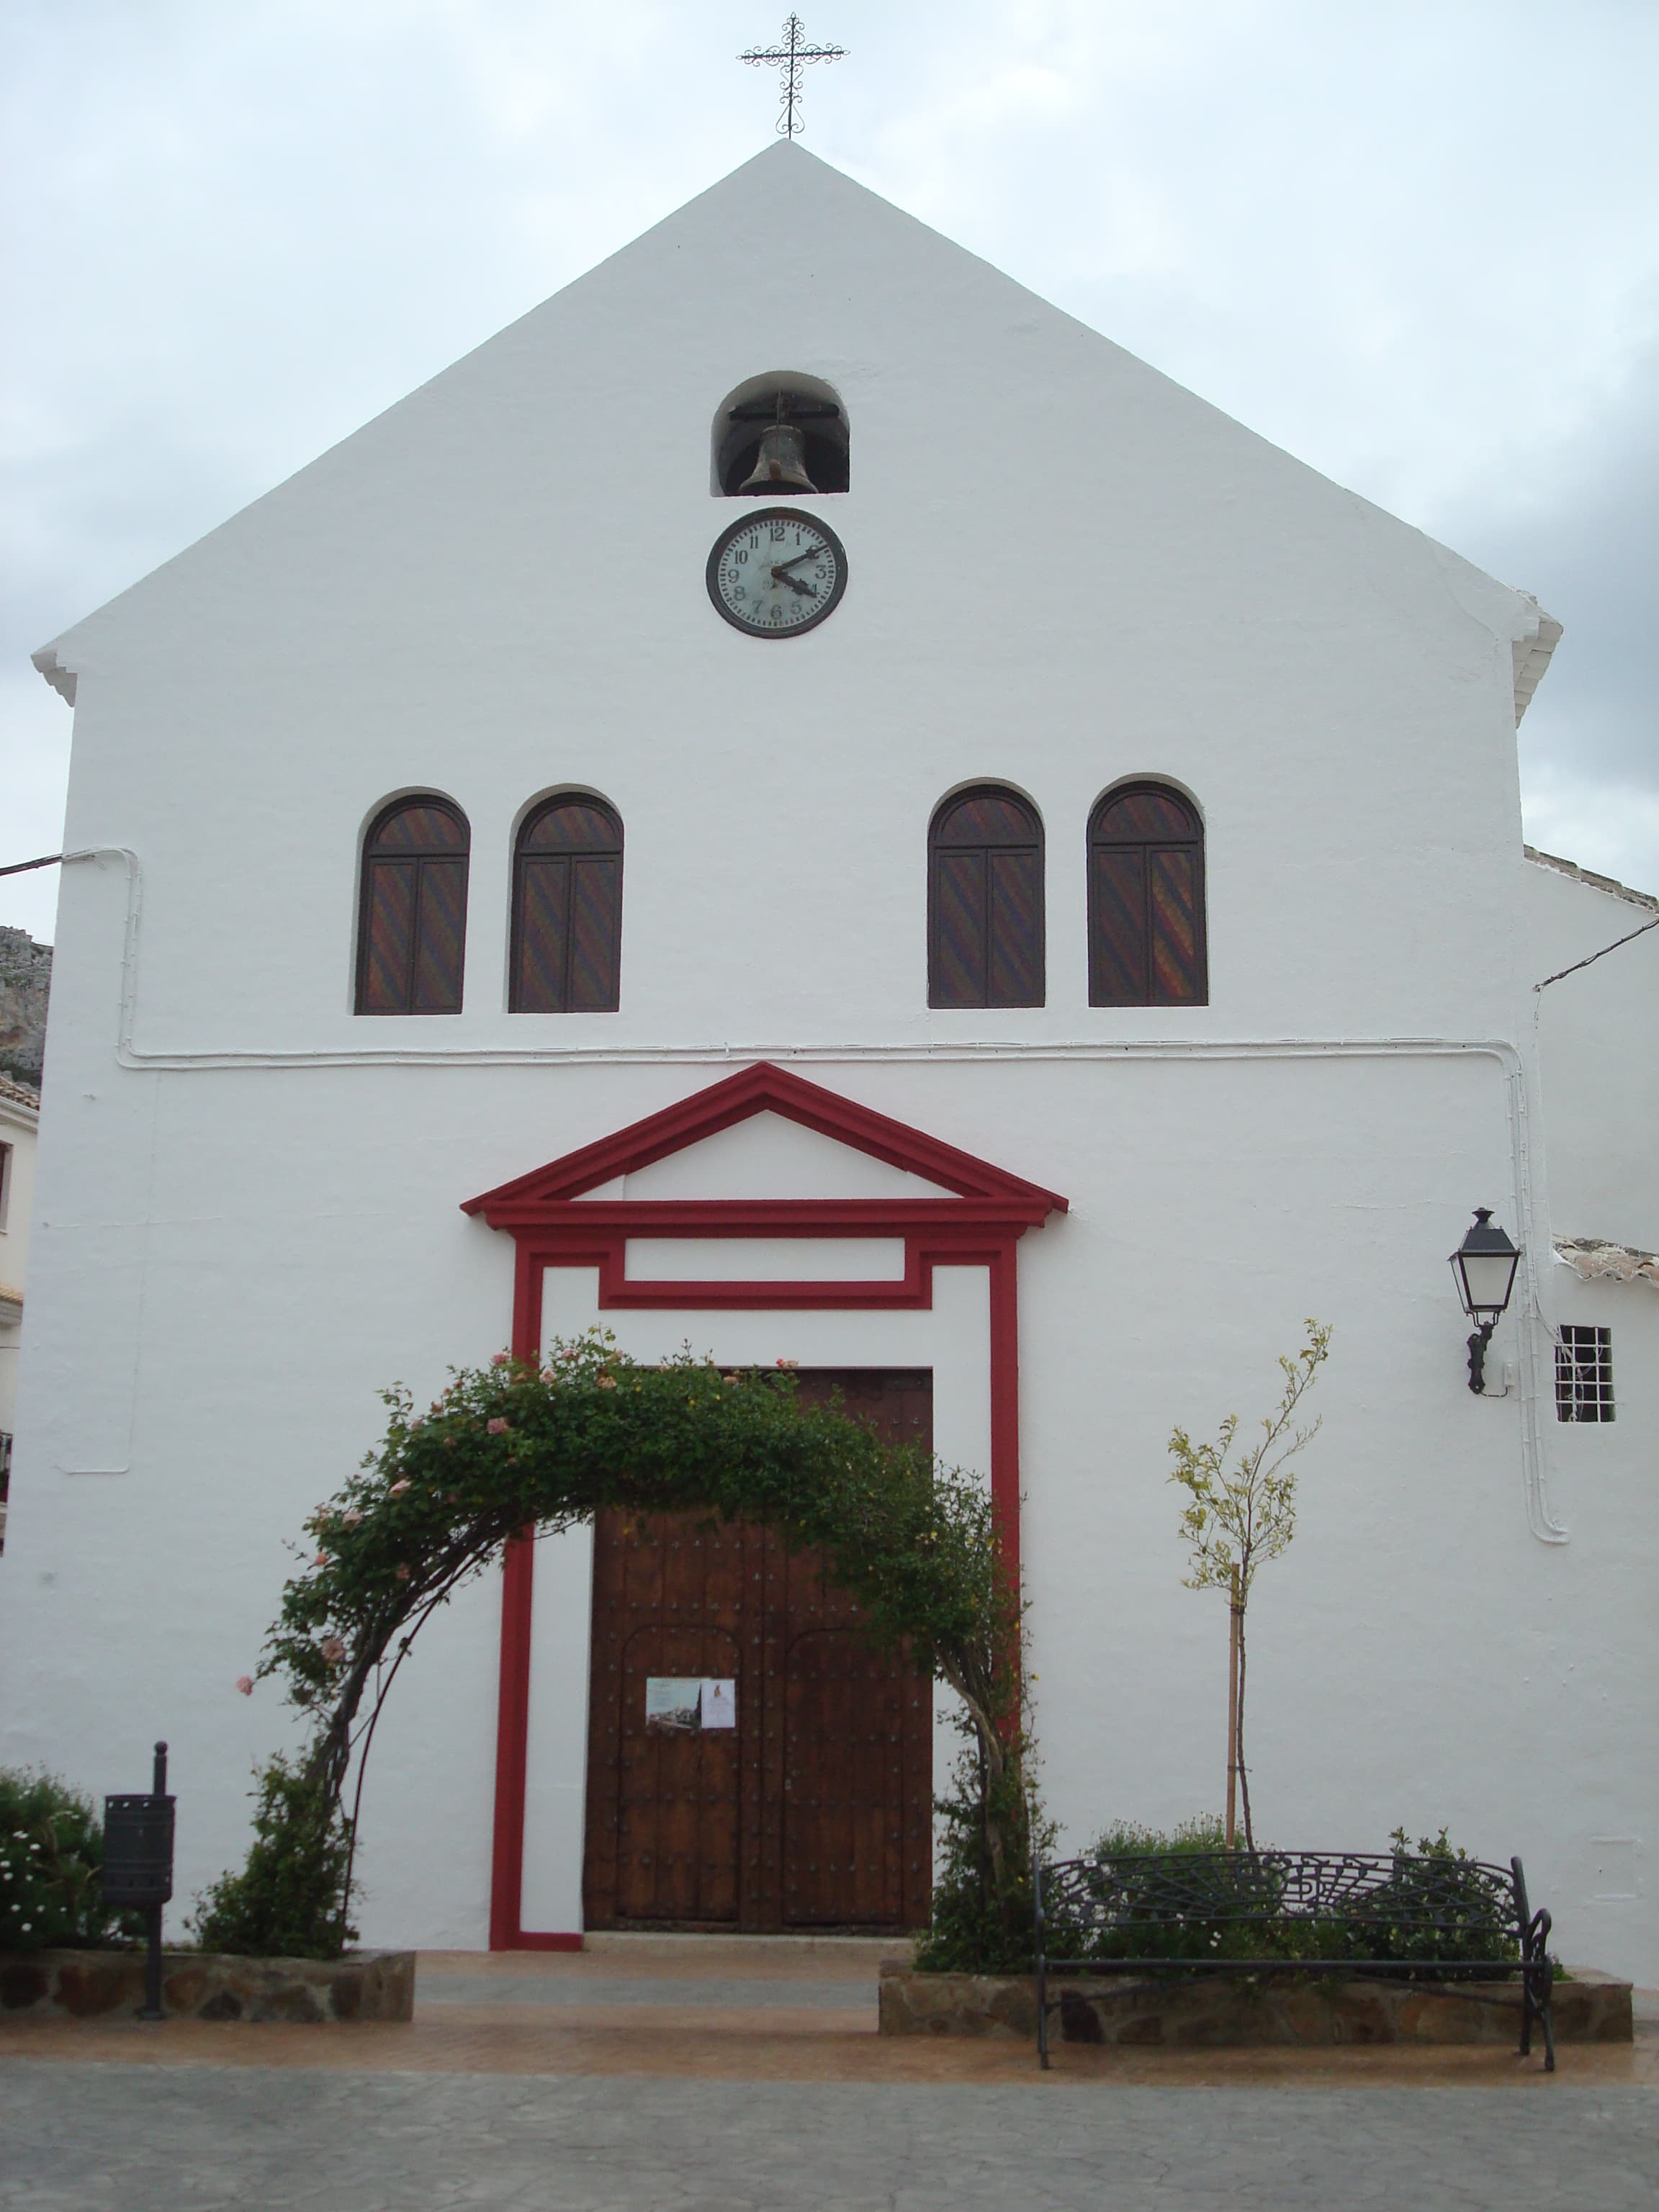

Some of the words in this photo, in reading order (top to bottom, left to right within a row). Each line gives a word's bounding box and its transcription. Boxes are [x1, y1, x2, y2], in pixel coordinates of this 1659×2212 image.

[770, 527, 786, 541] 12
[796, 532, 801, 546] 1
[750, 535, 759, 549] 11
[734, 550, 748, 565] 10
[728, 570, 739, 583] 9
[815, 565, 827, 579] 3
[734, 586, 745, 601] 8
[752, 600, 763, 613] 7
[770, 605, 782, 619] 6
[791, 601, 802, 614] 5
